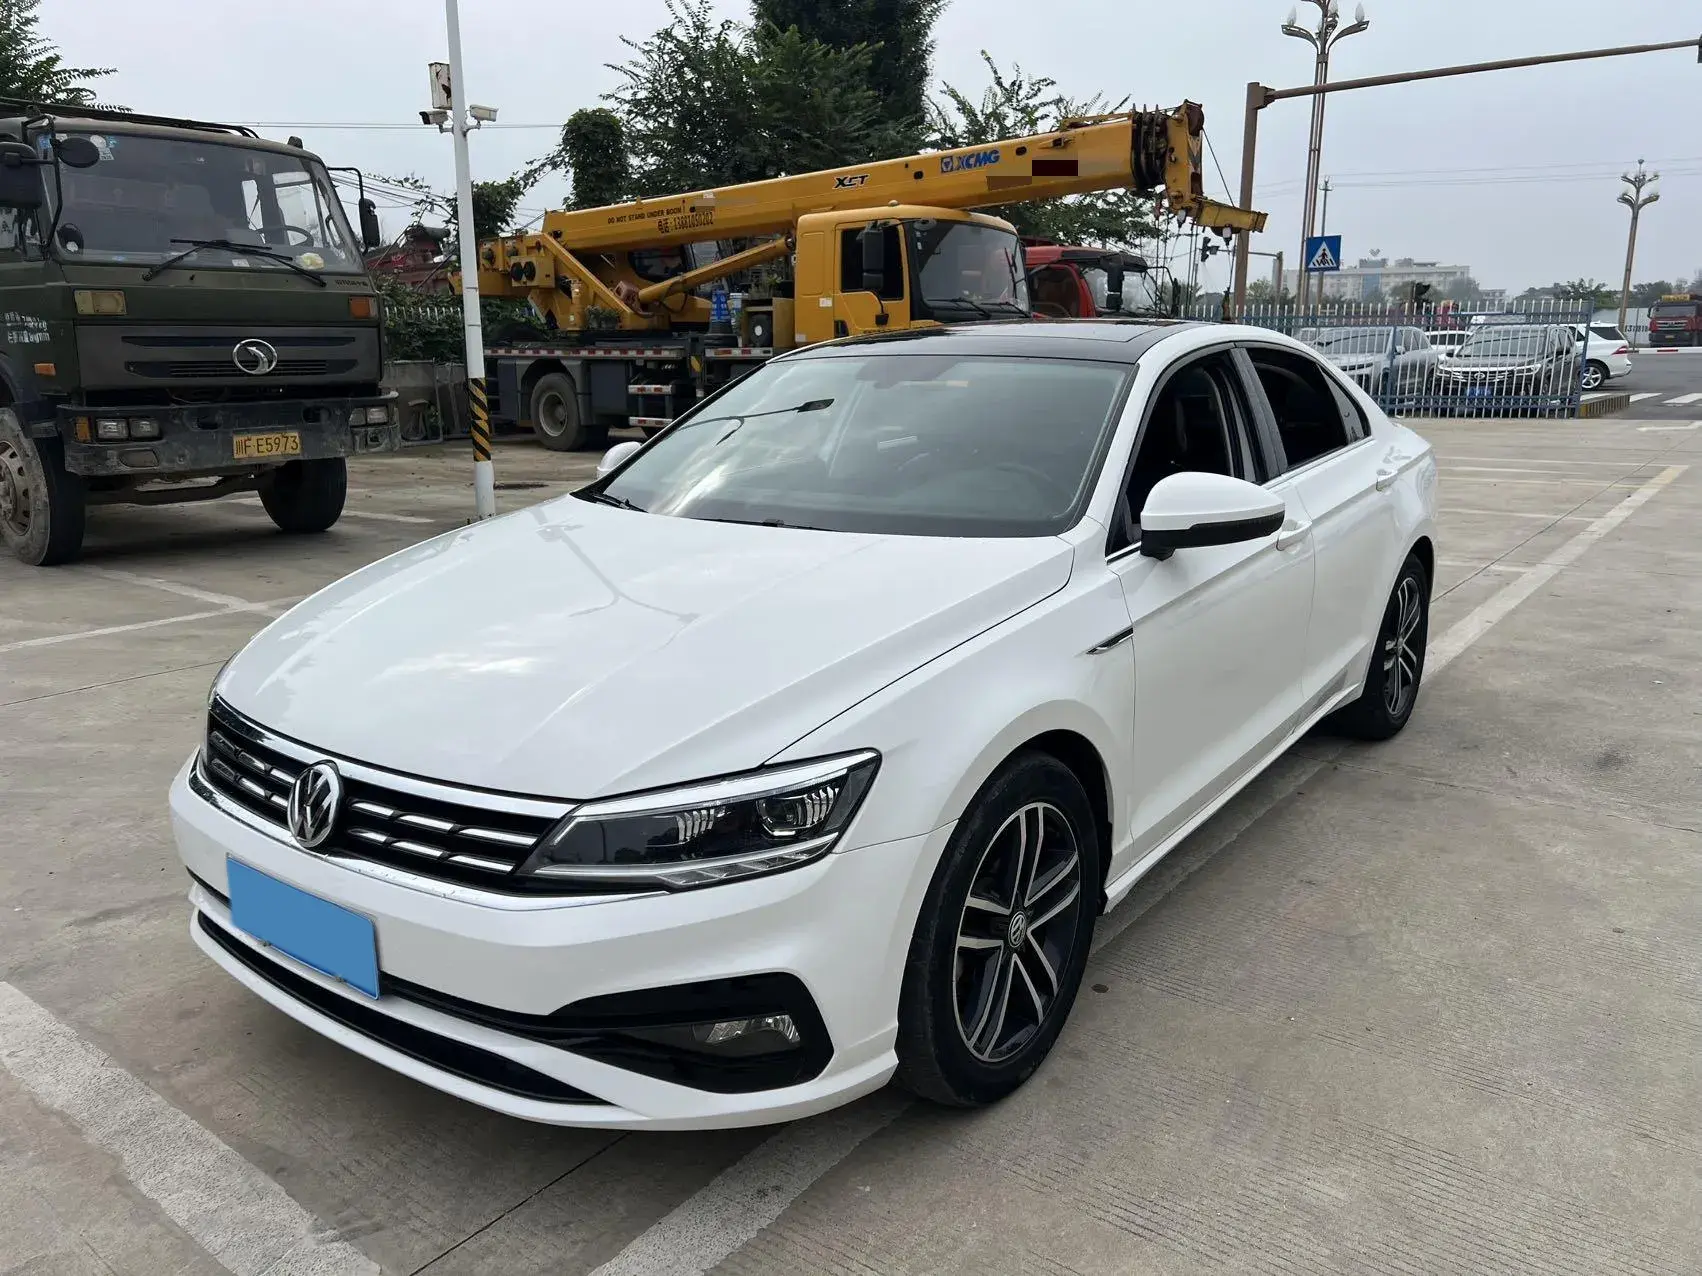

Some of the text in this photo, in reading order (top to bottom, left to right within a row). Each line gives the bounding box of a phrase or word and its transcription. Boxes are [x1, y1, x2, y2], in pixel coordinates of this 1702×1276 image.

[956, 149, 1000, 171] XCMG
[616, 215, 626, 223] NOT
[628, 212, 645, 221] STAND
[646, 209, 664, 218] UNDER
